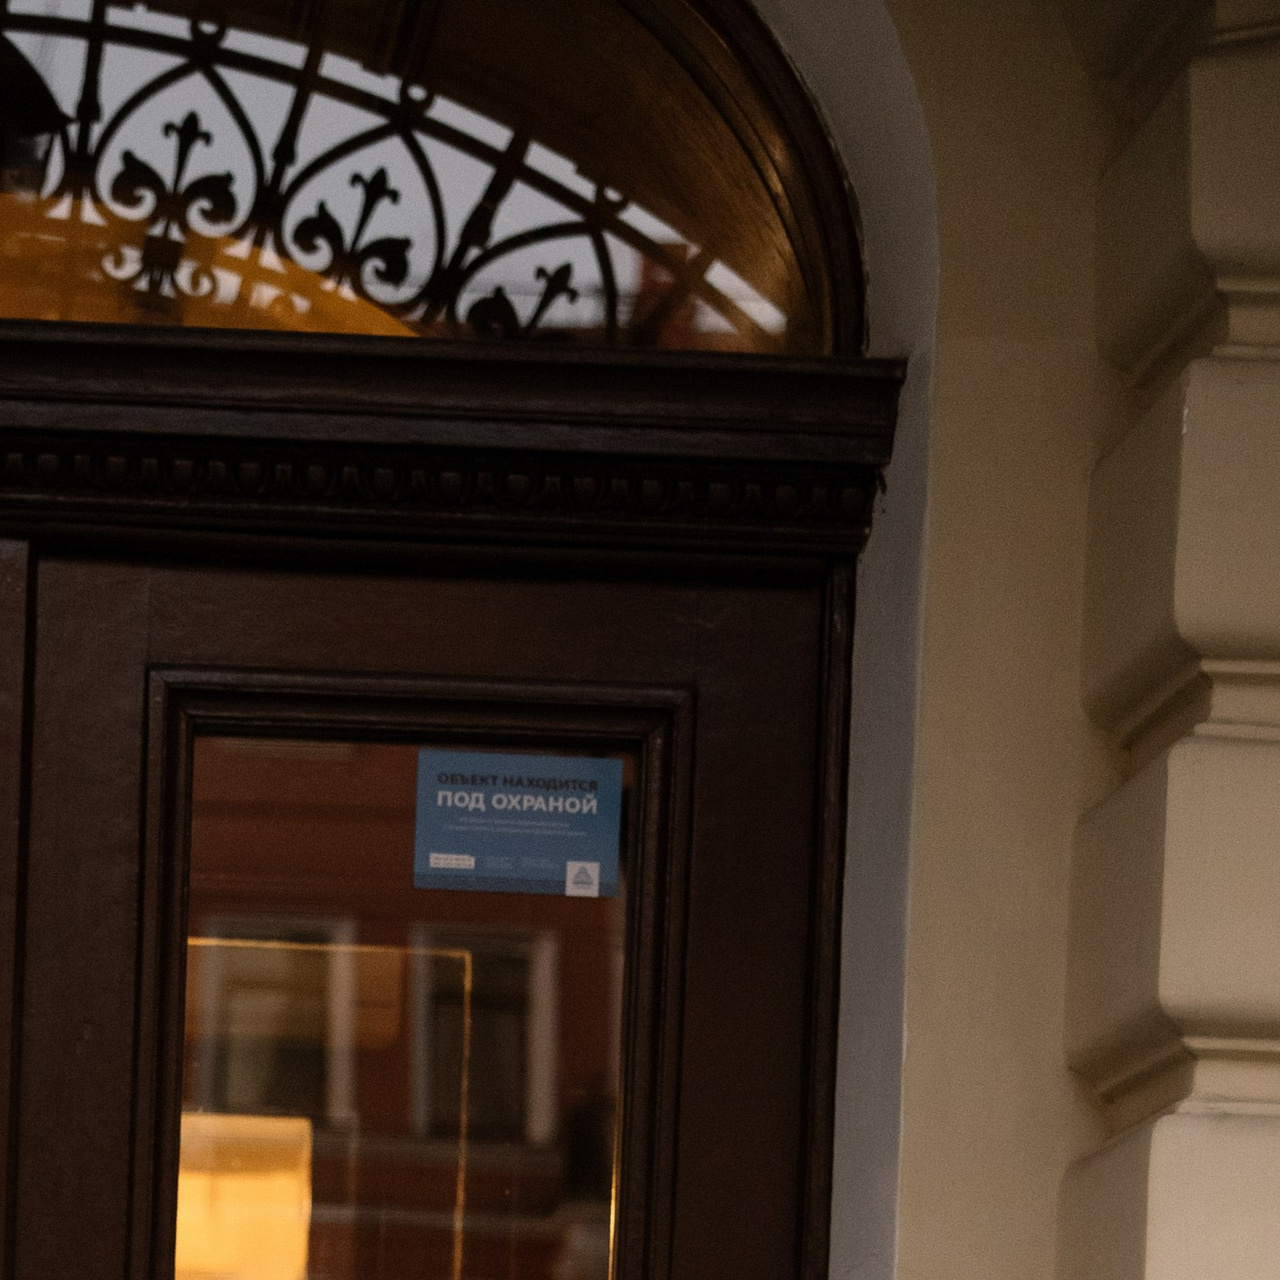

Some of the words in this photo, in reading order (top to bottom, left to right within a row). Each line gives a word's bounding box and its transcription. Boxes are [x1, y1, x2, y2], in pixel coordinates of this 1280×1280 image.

[437, 772, 499, 787] ОБЪЕКТ
[502, 775, 598, 792] НАХОДИТСЯ
[437, 790, 486, 812] ПОД
[491, 793, 598, 815] ОХРАНОЙ
